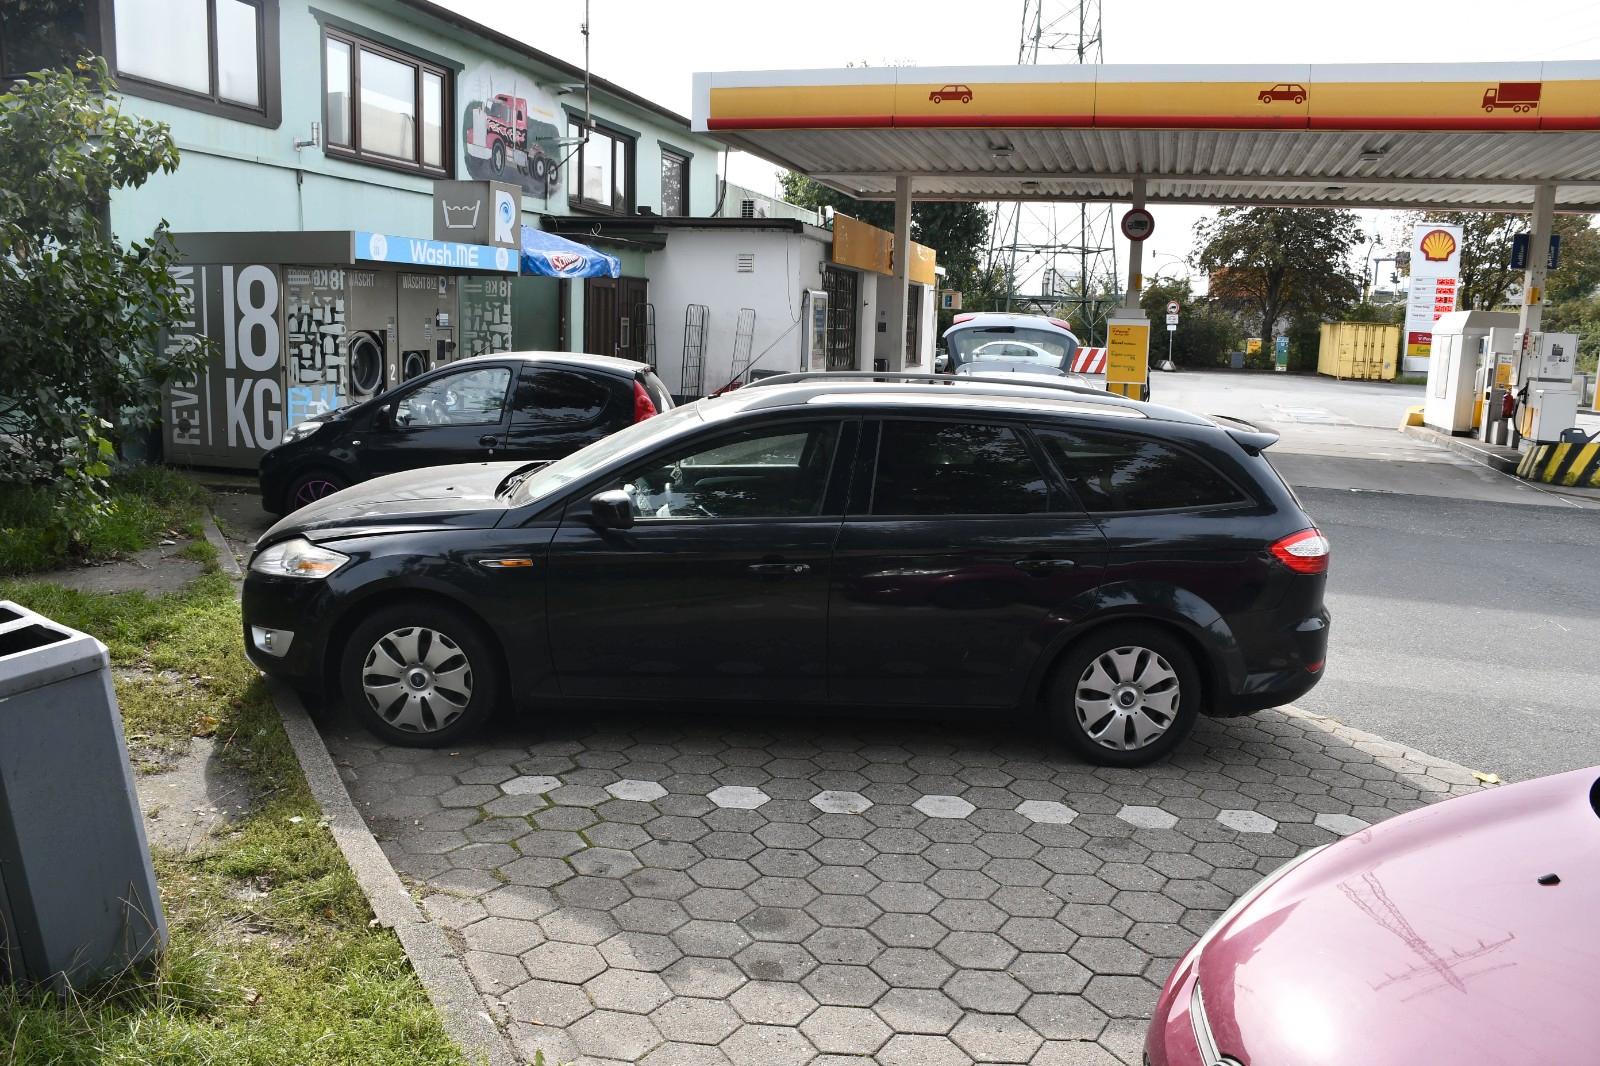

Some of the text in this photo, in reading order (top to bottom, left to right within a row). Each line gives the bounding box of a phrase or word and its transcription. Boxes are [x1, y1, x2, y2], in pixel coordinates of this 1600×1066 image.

[410, 239, 479, 267] Wash.ME
[222, 264, 279, 372] 18
[390, 363, 396, 381] 2
[226, 377, 281, 450] KG
